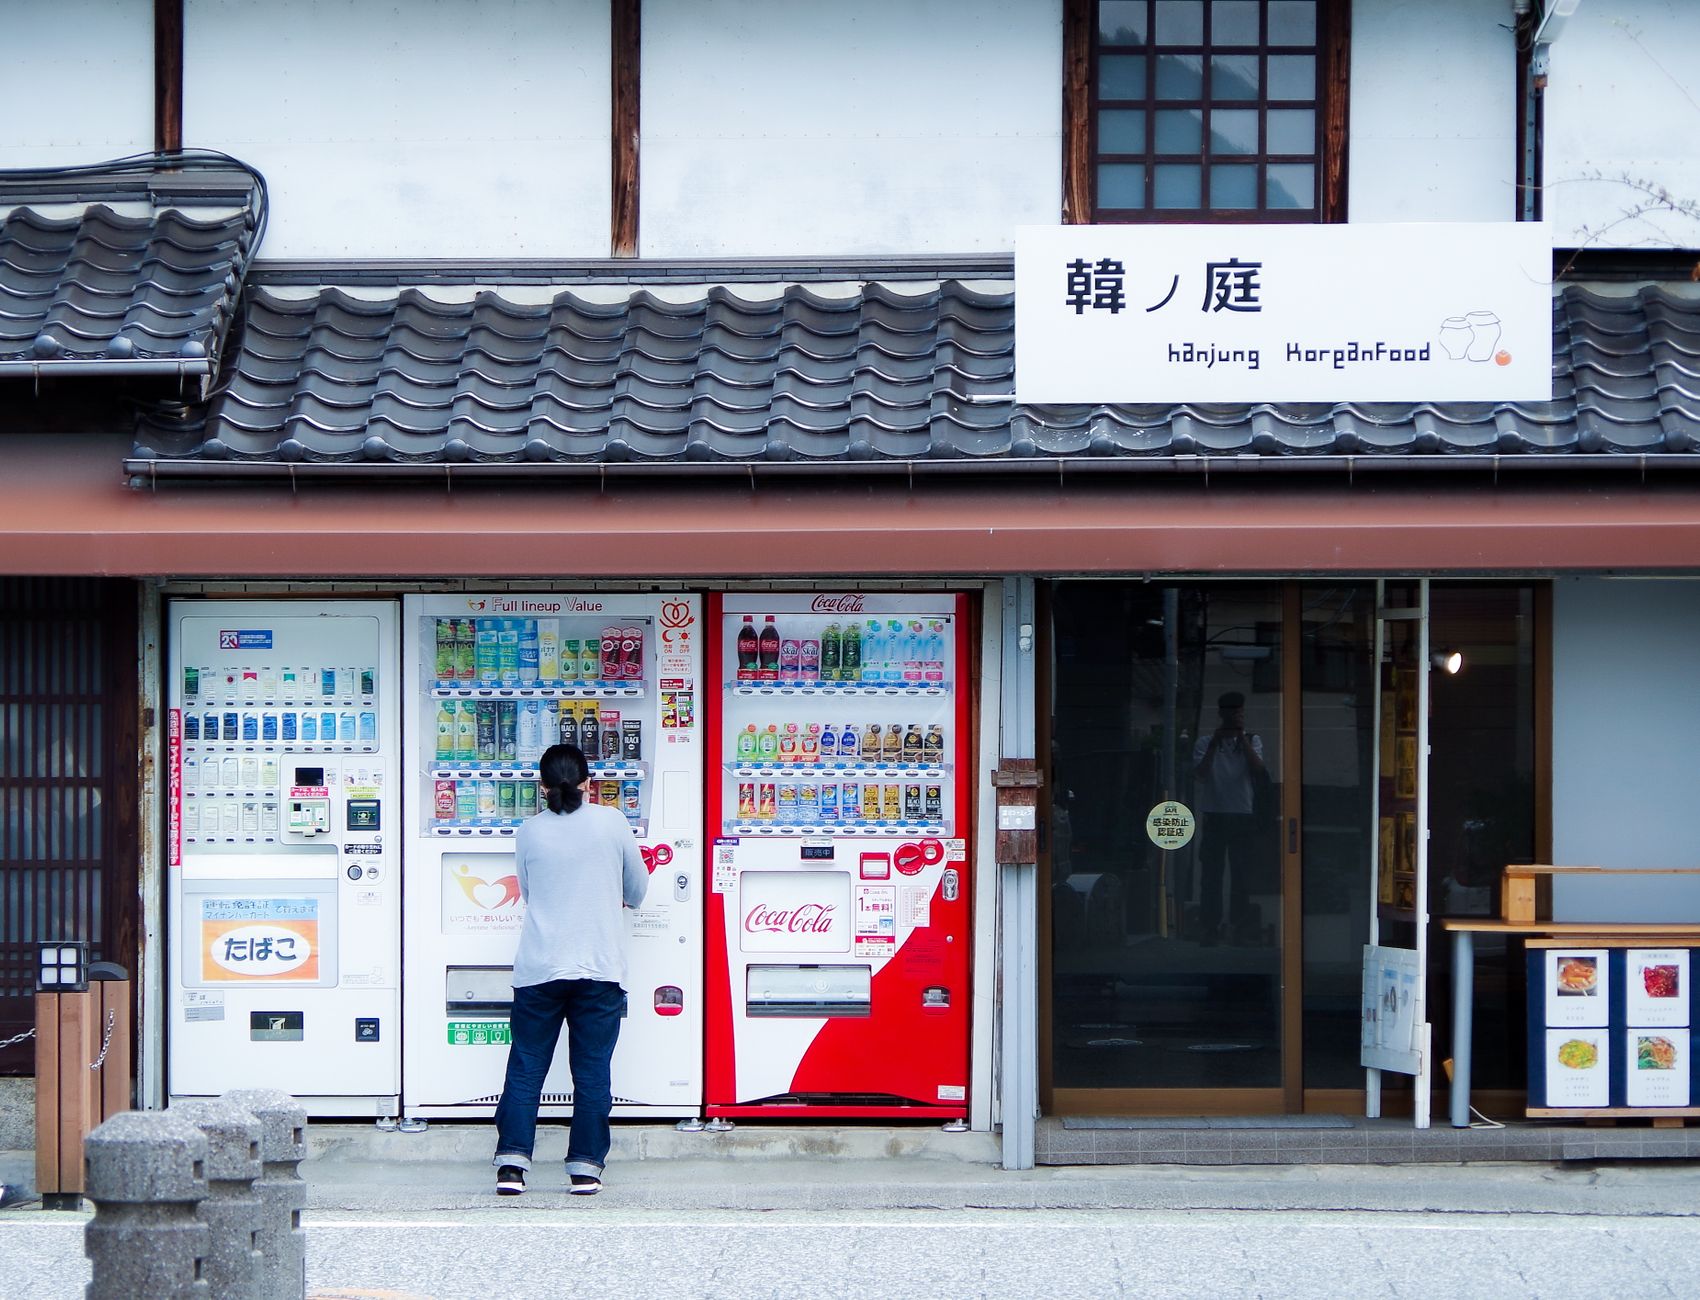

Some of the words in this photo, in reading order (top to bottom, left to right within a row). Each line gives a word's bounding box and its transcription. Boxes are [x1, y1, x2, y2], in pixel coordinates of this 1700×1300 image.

[1066, 257, 1262, 315] 韓ノ庭
[1168, 343, 1260, 369] hanjung
[491, 597, 518, 612] Full
[521, 598, 561, 614] lineup
[564, 597, 603, 612] Value
[224, 937, 297, 962] たばこ
